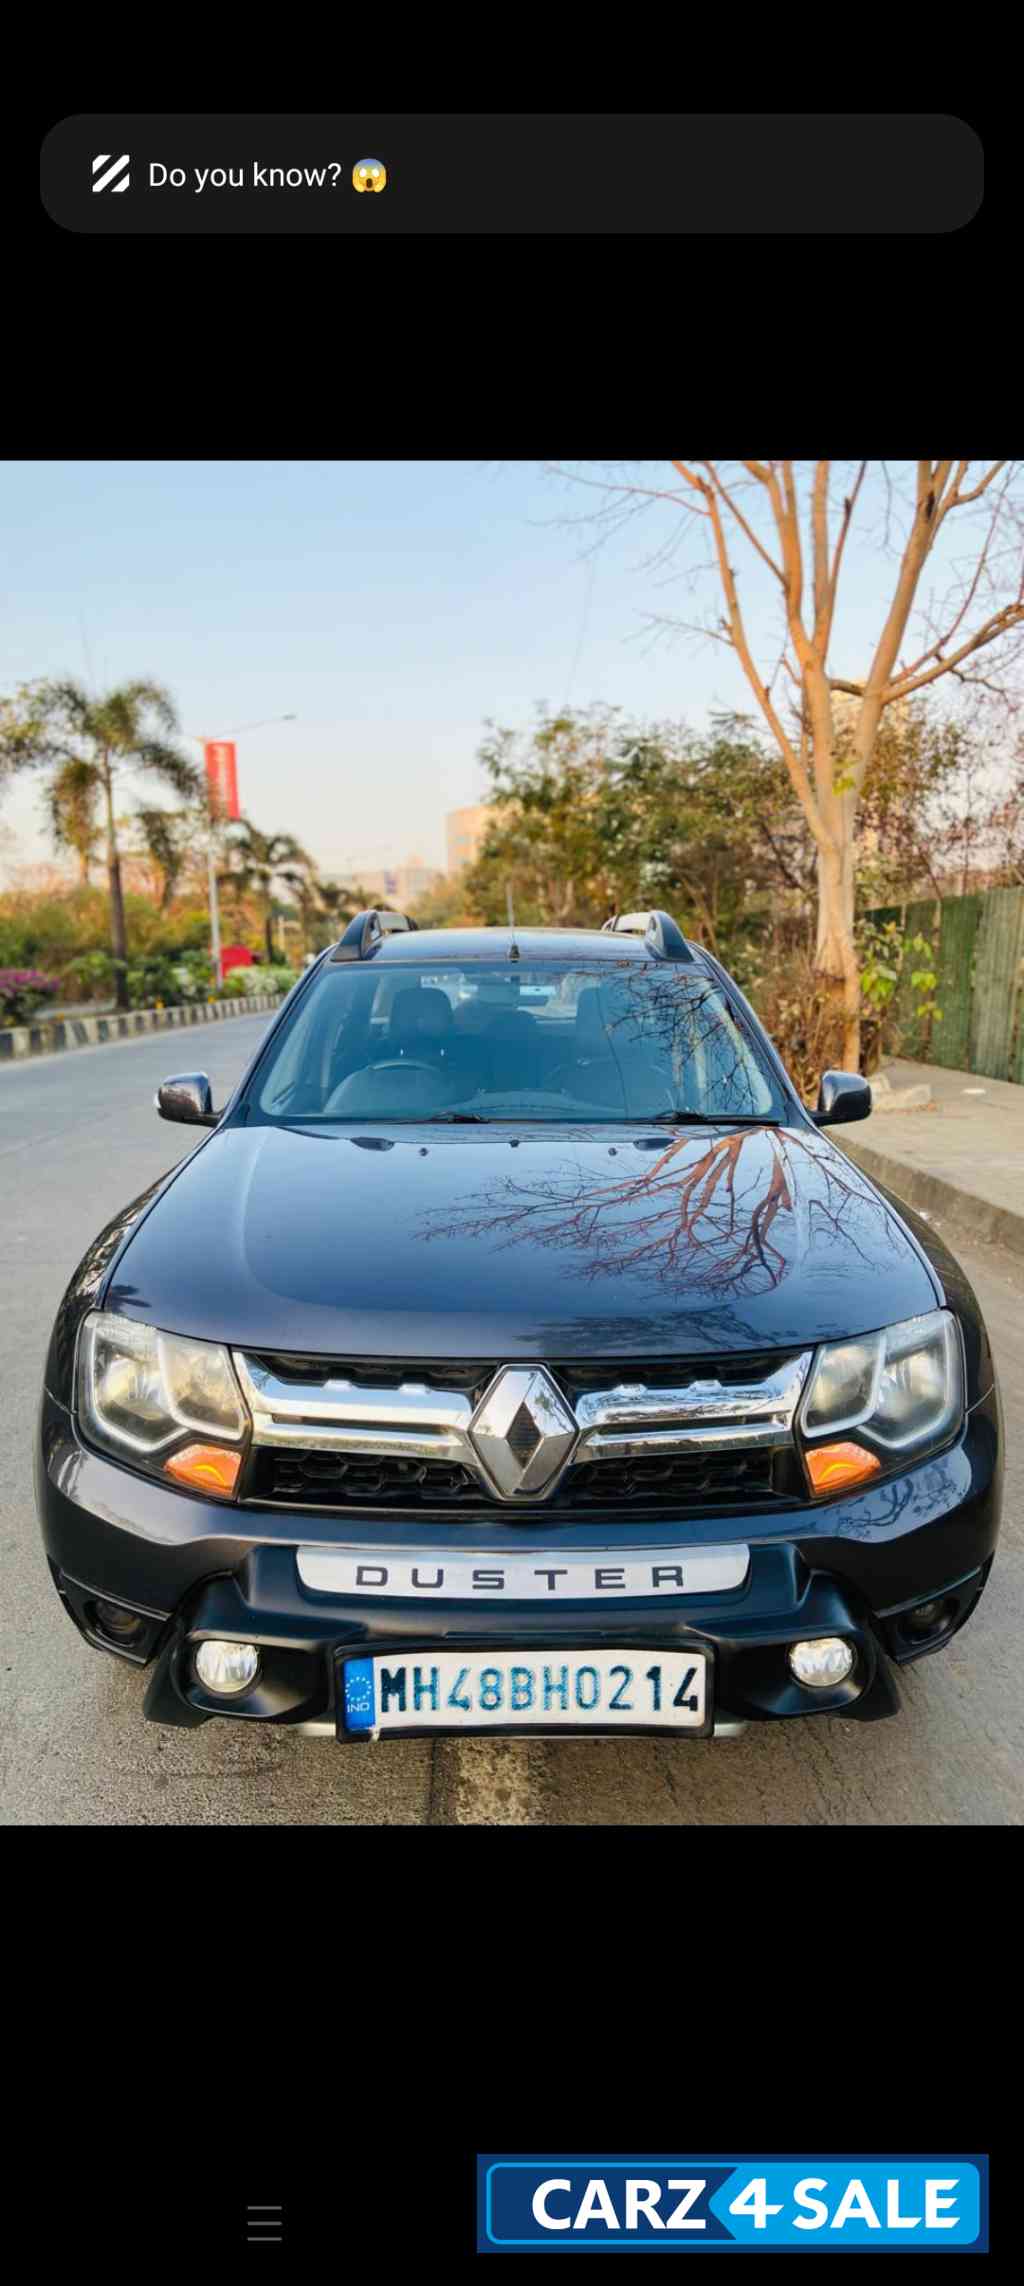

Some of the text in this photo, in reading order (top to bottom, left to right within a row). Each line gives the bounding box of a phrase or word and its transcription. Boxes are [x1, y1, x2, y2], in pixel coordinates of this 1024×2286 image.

[355, 1565, 684, 1591] DUSTER
[380, 1665, 699, 1713] MH48BH0214
[347, 1702, 370, 1713] IND
